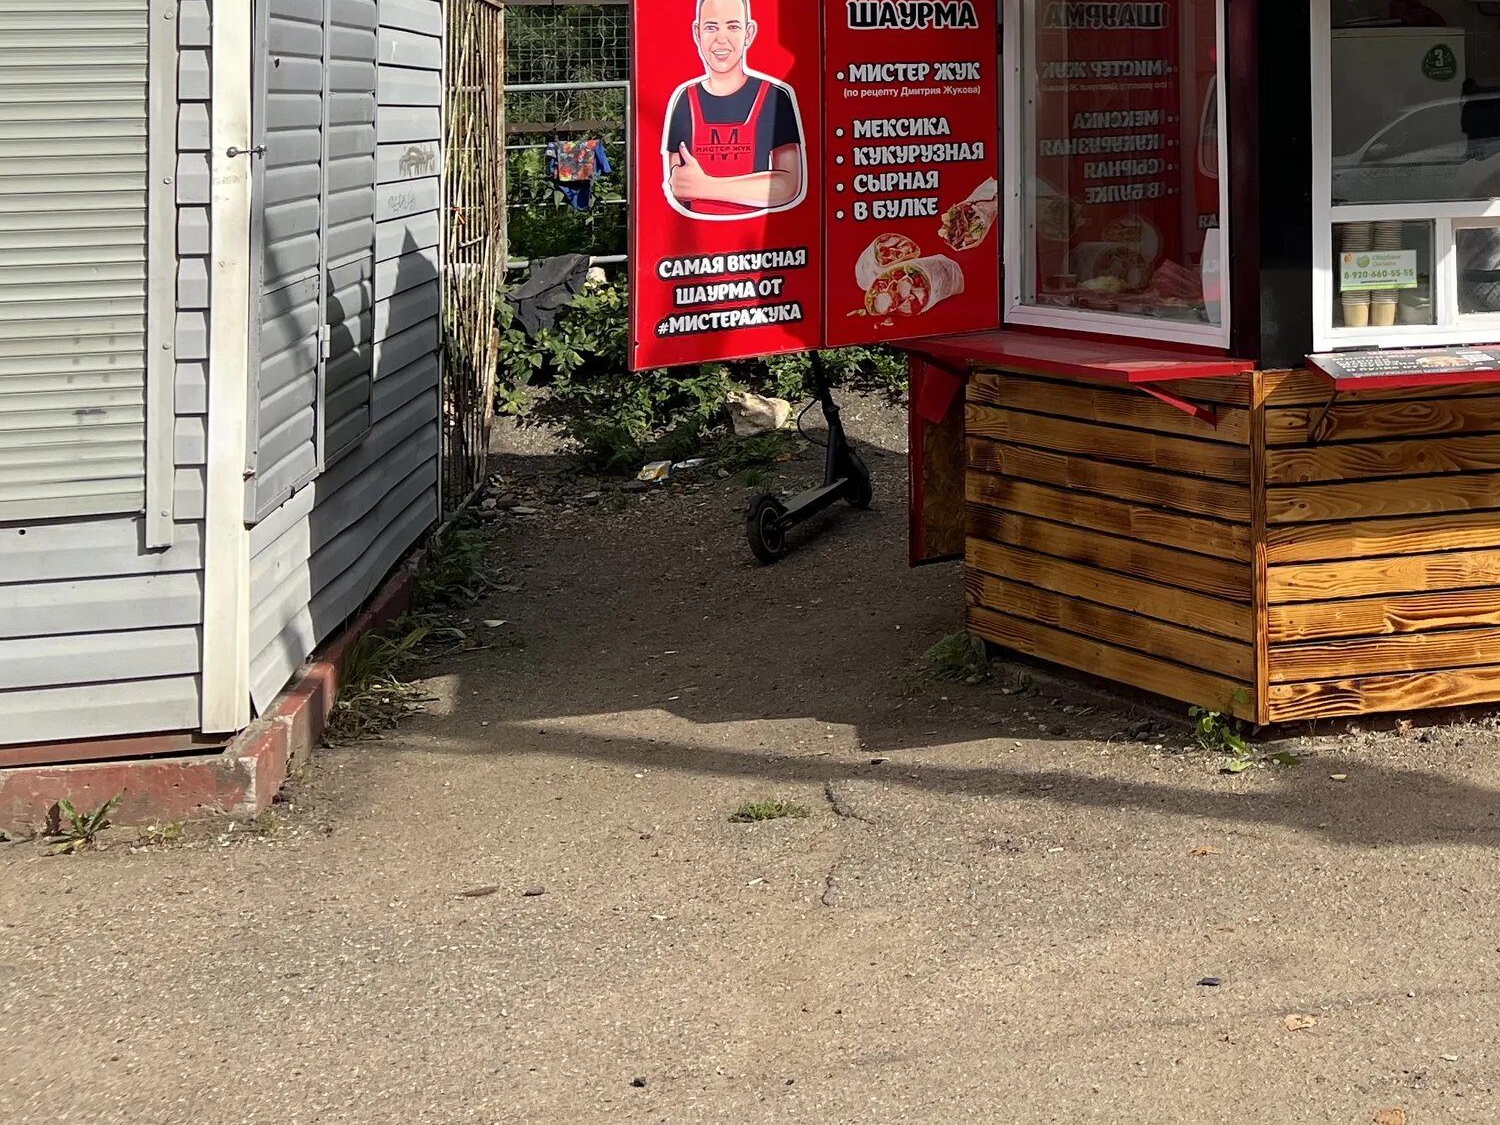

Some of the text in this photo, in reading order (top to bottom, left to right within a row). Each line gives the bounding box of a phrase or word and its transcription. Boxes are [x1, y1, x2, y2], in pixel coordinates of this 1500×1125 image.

[847, 0, 978, 29] ШАУРМА
[849, 62, 981, 82] МИСТЕР ЖУК
[861, 87, 898, 99] рецепту
[900, 86, 941, 97] Дмитрия
[943, 85, 981, 96] Жукова)
[853, 117, 950, 138] МЕКСИКА
[853, 142, 984, 166] КУКУРУЗНАЯ
[853, 170, 939, 193] СЫРНАЯ
[854, 197, 939, 220] В БУЛКЕ
[658, 249, 806, 278] САМАЯ ВКУСНАЯ
[676, 278, 782, 305] ШАУРМА ОТ
[657, 303, 802, 335] #МИСТЕРАЖУКА
